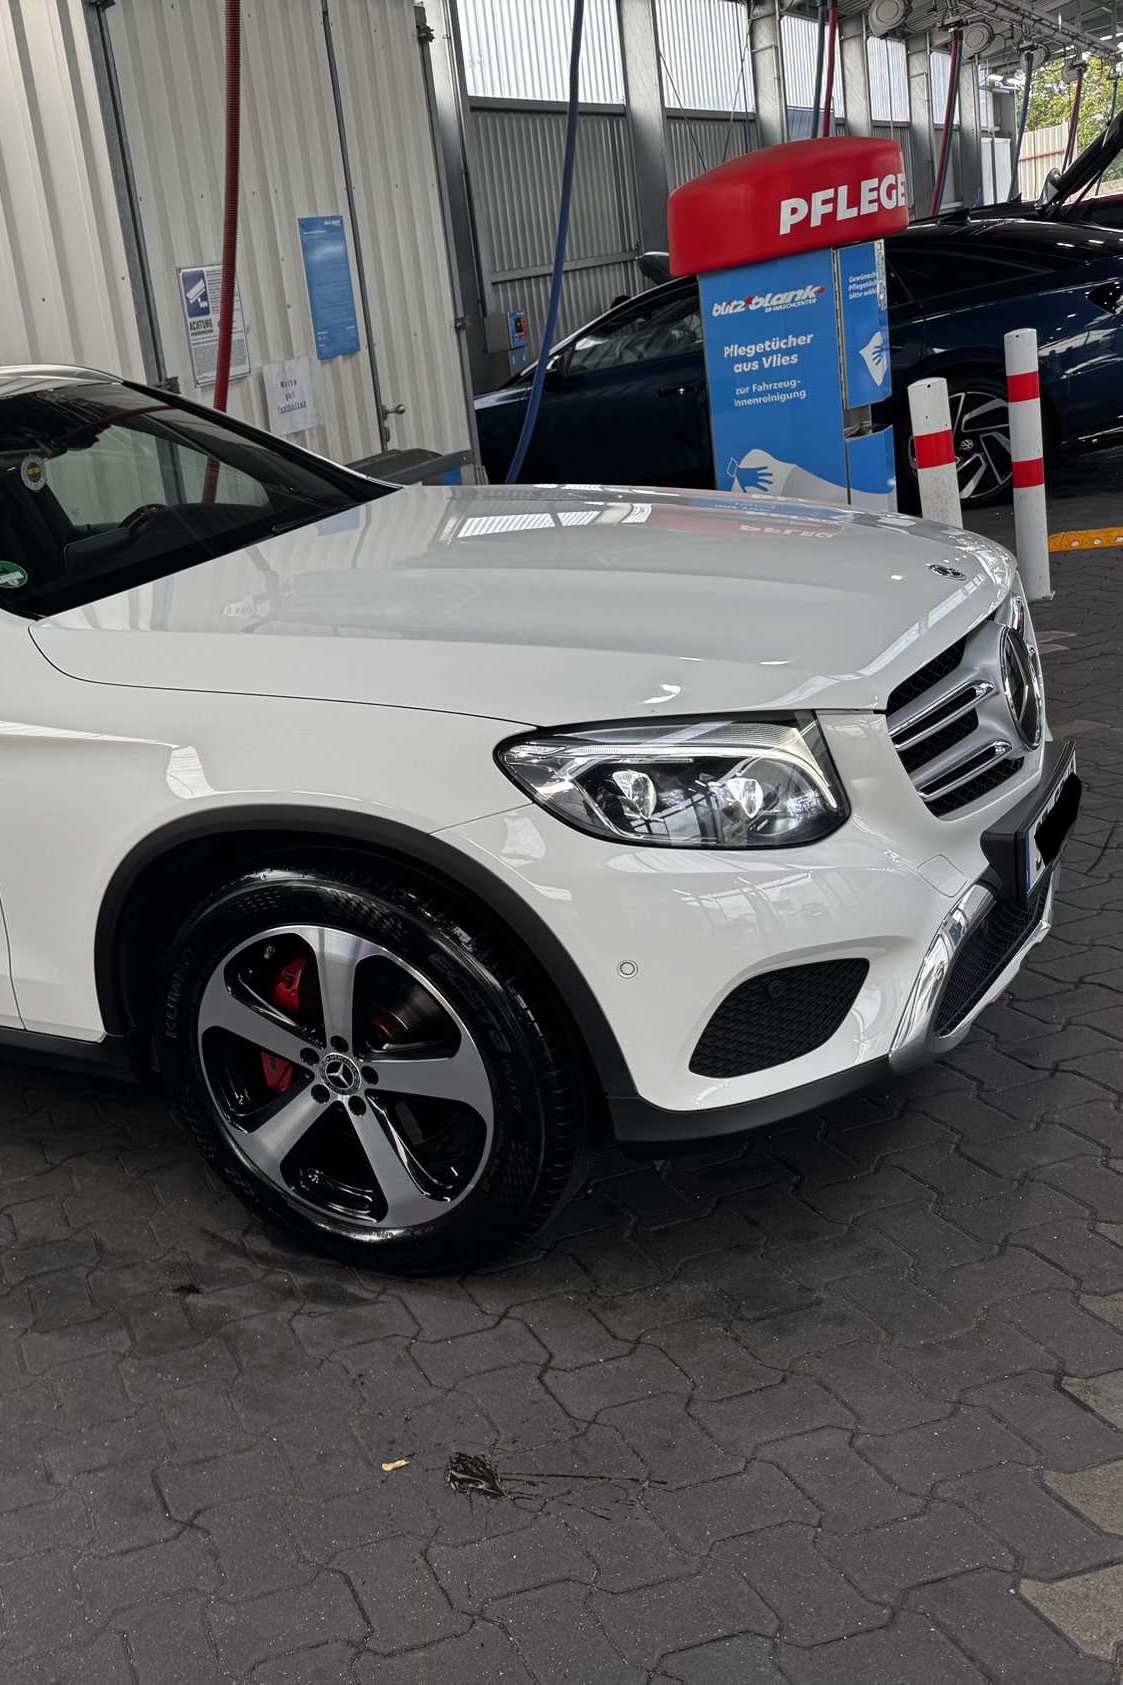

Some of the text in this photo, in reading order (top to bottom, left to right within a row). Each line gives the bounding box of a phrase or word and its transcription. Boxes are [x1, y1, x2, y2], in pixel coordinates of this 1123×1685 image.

[779, 173, 907, 235] PFLEGE
[723, 333, 814, 358] Pflegetücher
[733, 354, 798, 373] aus Vlies
[735, 379, 801, 395] zur Fahrzeug-
[734, 390, 807, 407] Innenreinigung
